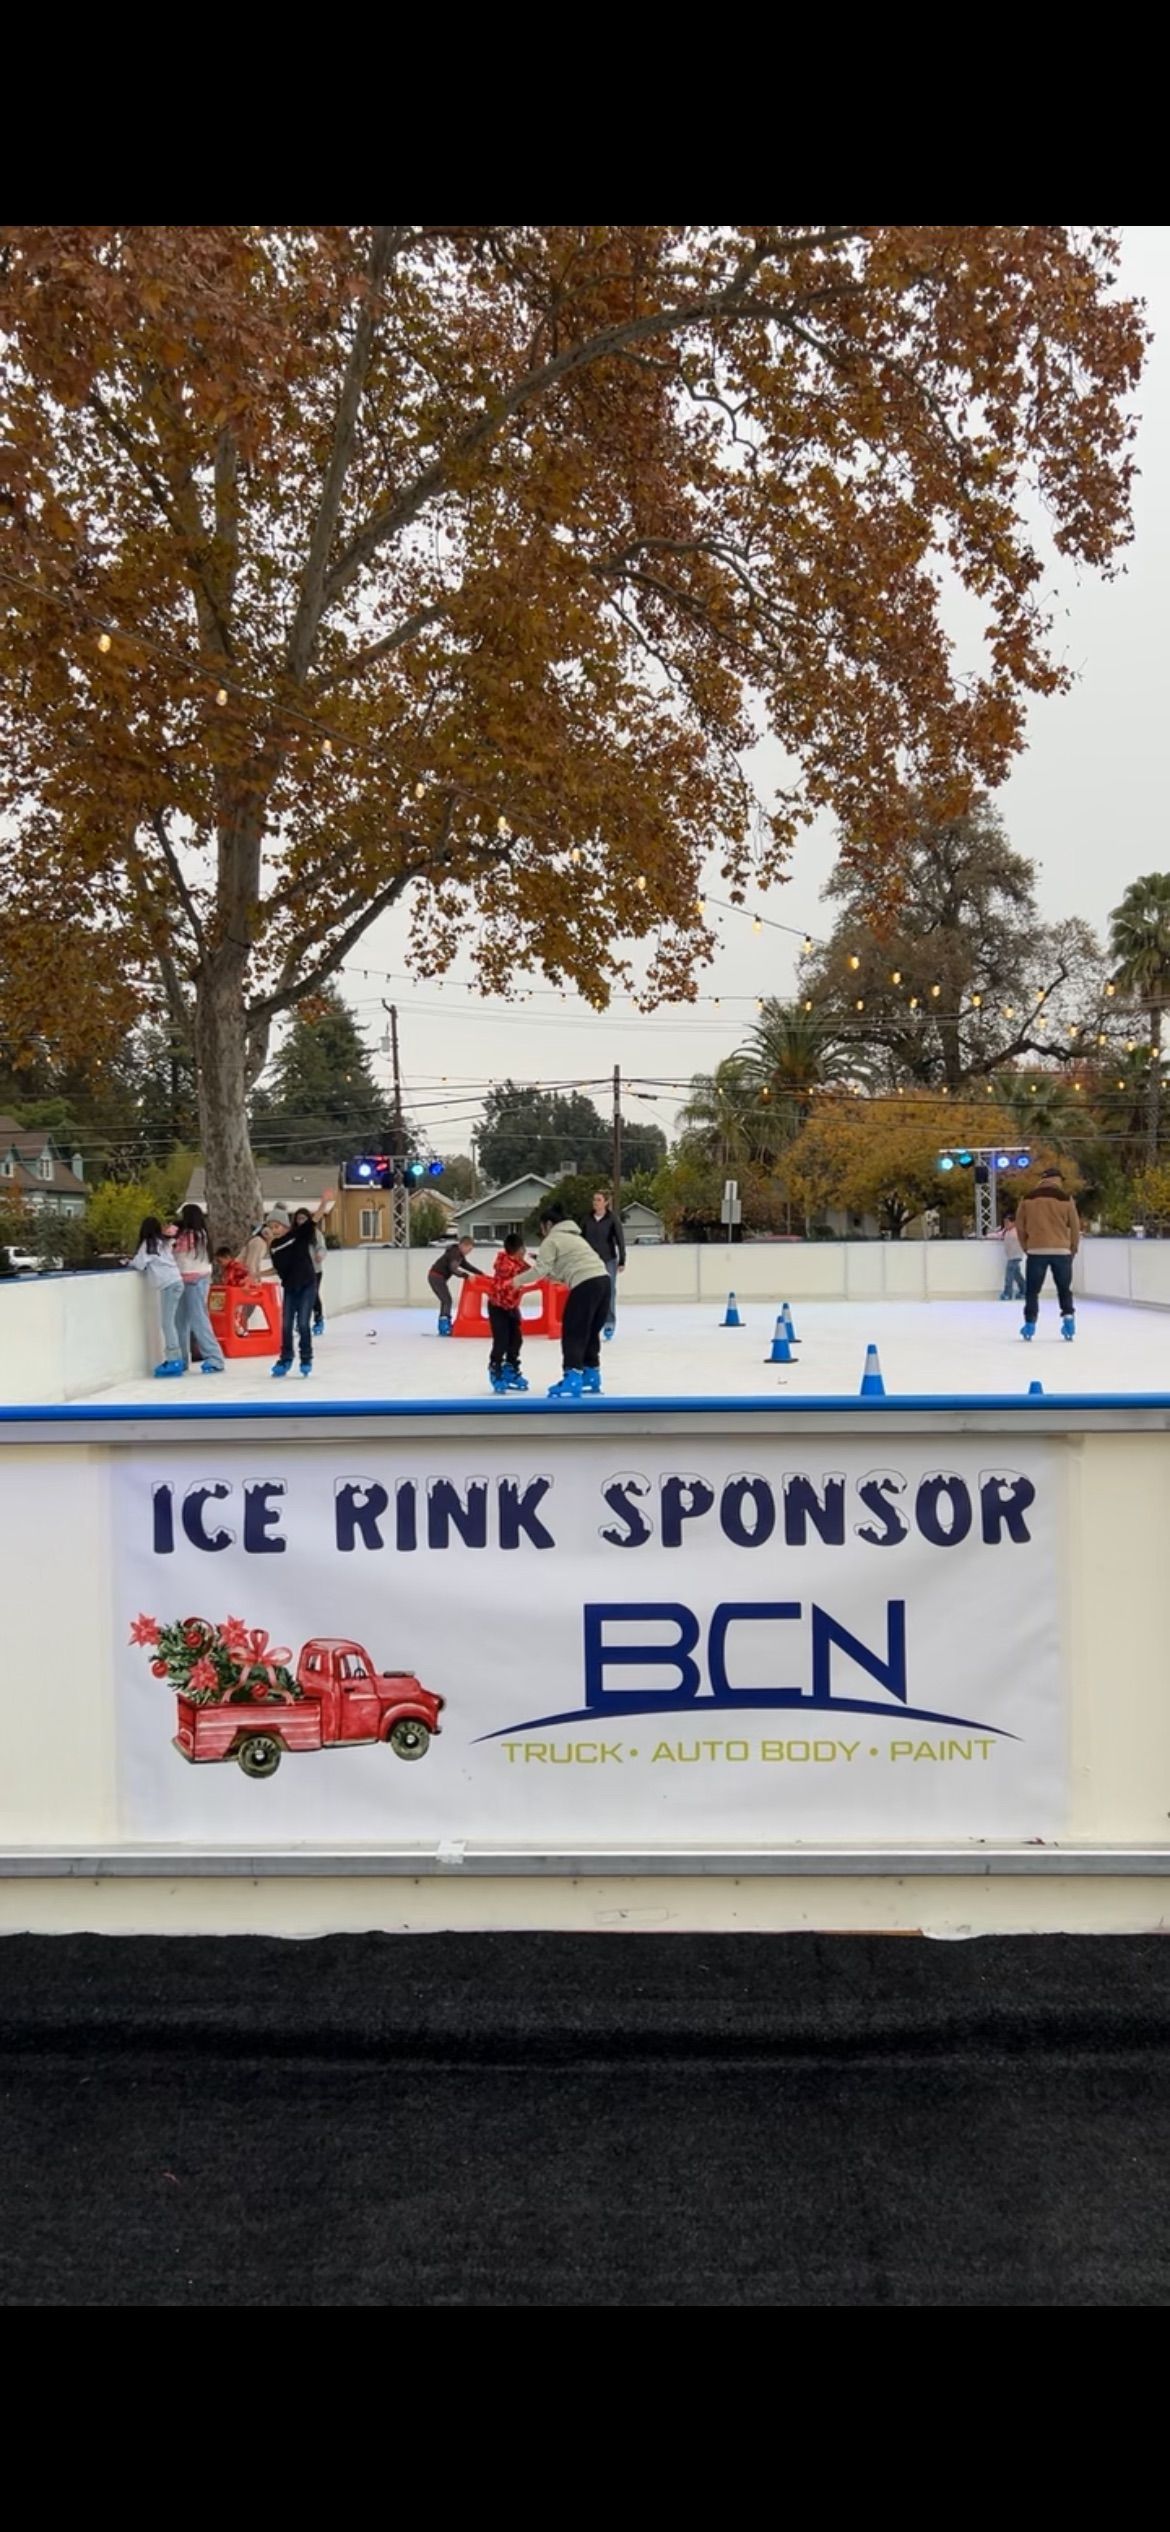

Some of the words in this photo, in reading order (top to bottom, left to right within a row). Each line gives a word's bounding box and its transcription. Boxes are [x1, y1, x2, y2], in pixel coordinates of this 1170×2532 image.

[150, 1478, 289, 1555] ICE
[333, 1474, 557, 1553] RINK
[598, 1469, 1037, 1549] SPONSOR
[582, 1599, 908, 1708] BCN
[502, 1742, 623, 1764] TRUCK
[651, 1741, 750, 1762] AUTO
[760, 1739, 862, 1763] BODY
[890, 1739, 997, 1761] PAINT
